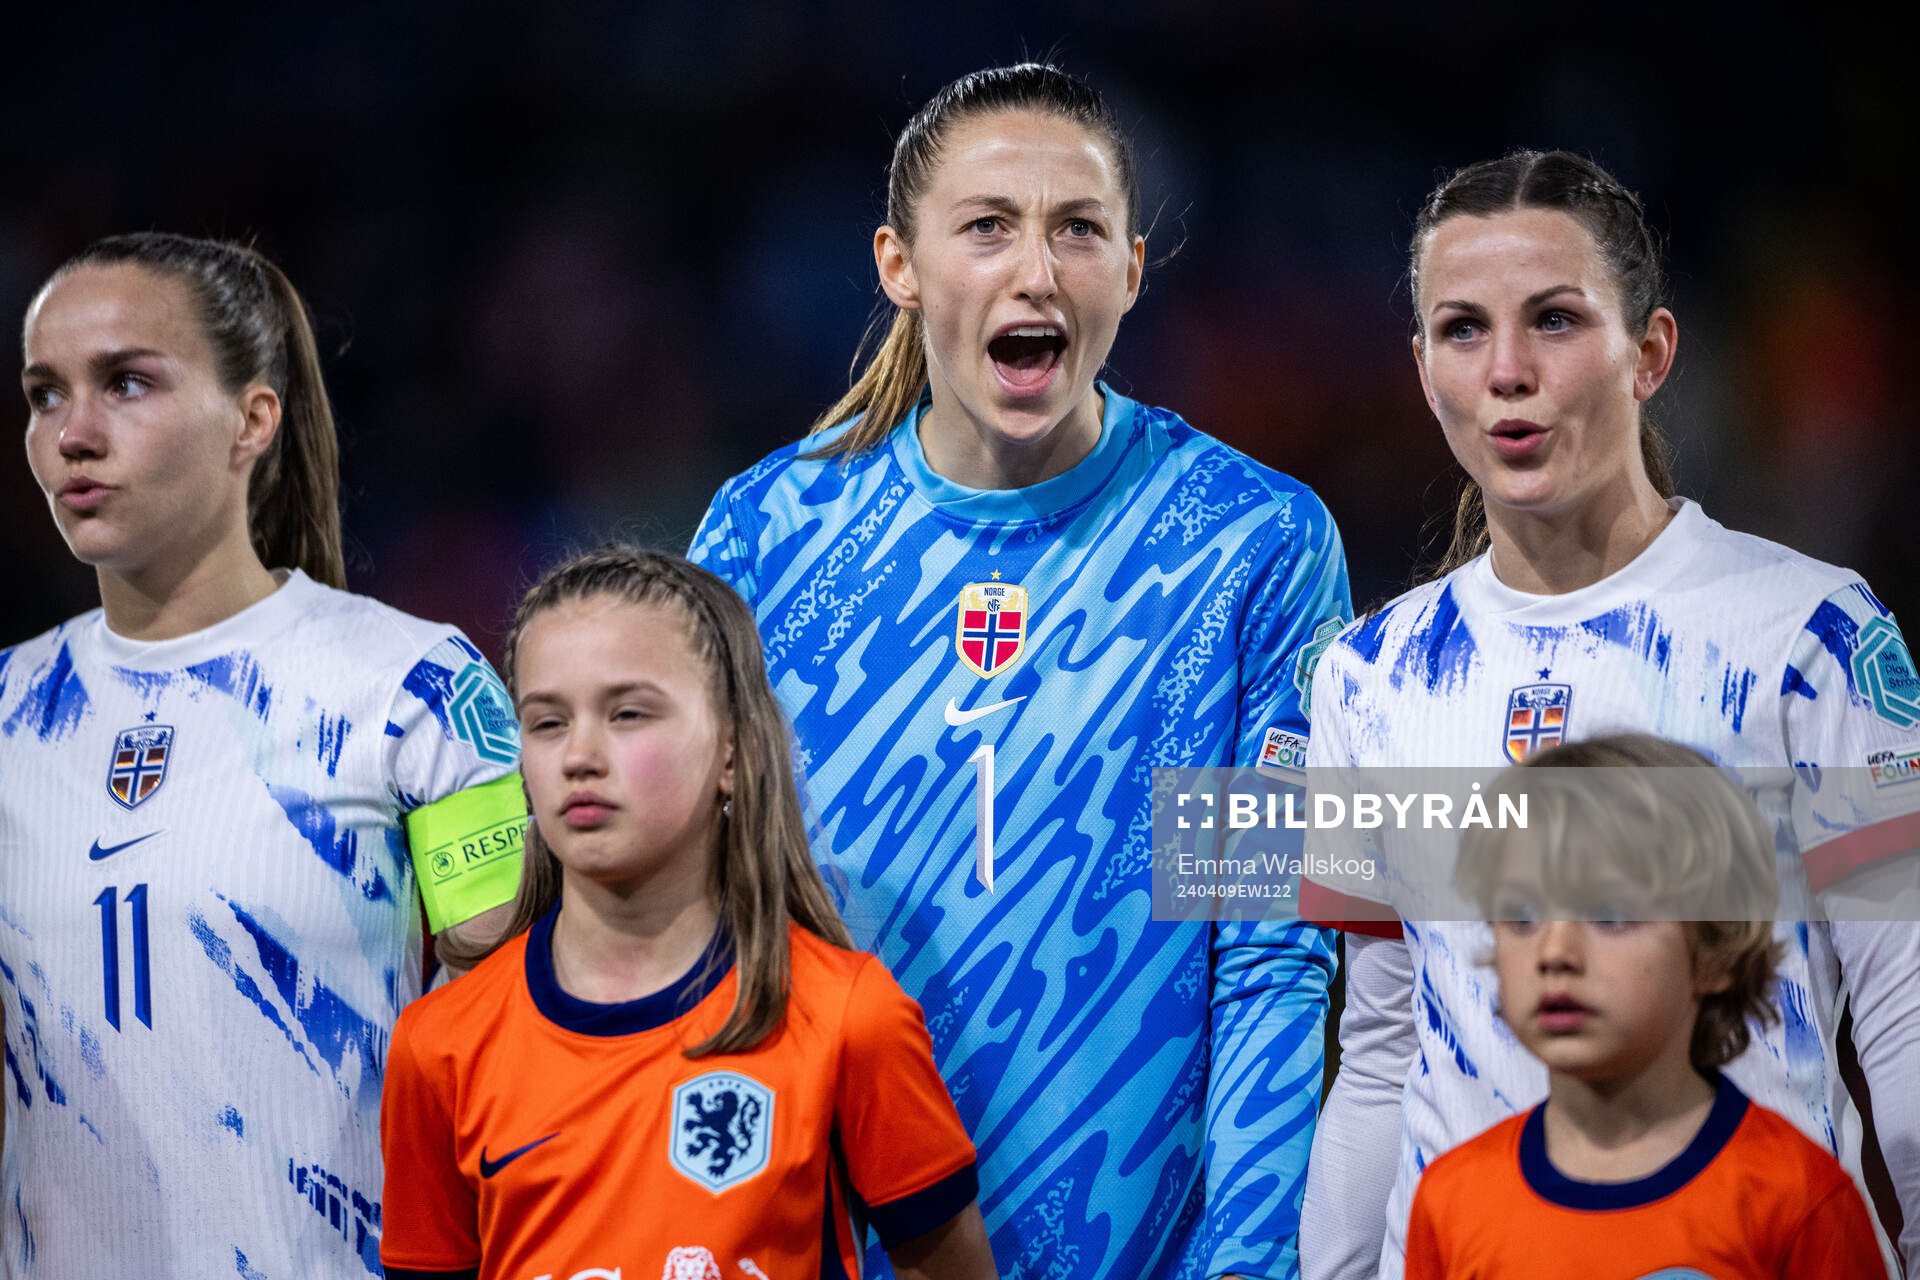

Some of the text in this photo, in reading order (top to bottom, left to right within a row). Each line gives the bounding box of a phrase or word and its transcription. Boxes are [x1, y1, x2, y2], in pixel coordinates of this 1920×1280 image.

[984, 587, 1005, 596] NORGE
[1885, 664, 1909, 678] Play
[1269, 731, 1300, 748] UEFA
[1867, 751, 1895, 766] UEFA
[967, 744, 995, 895] 1
[92, 883, 152, 1034] 11
